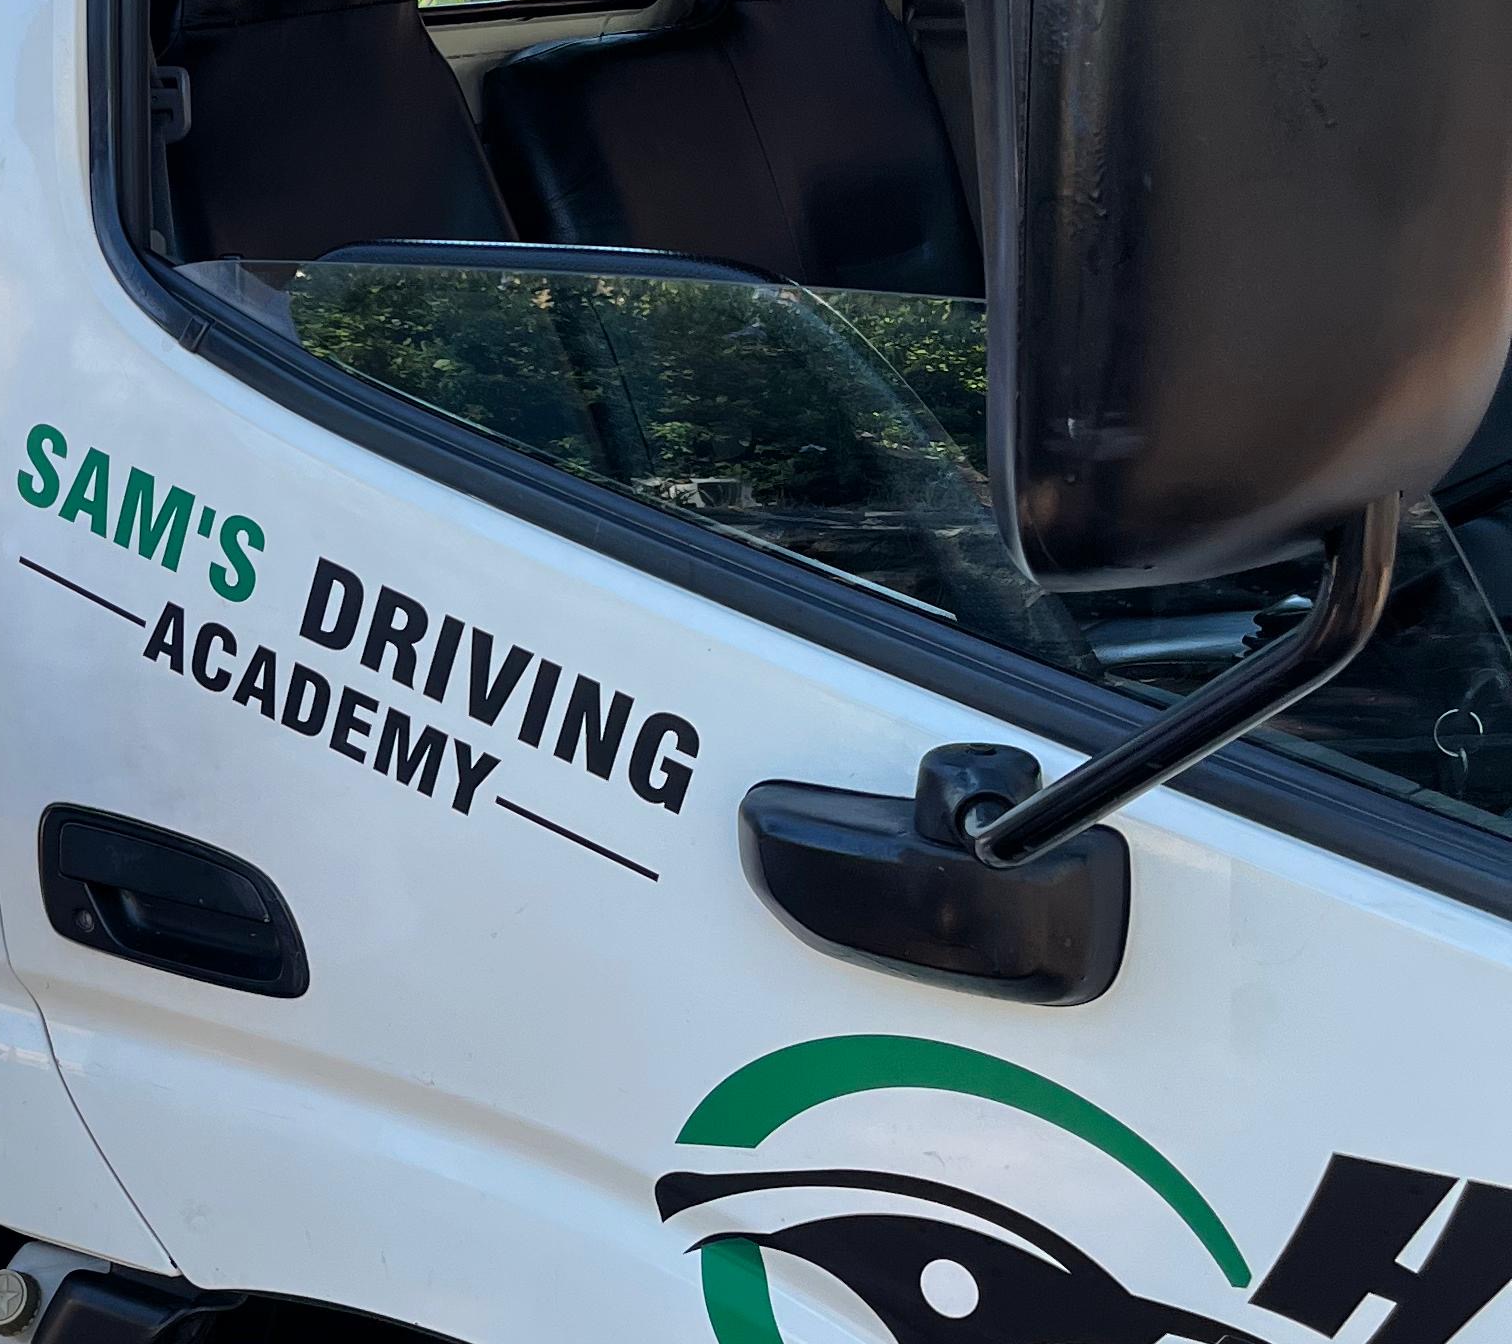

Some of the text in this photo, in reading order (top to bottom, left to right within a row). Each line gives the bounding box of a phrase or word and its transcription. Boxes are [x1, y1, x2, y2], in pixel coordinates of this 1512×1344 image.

[17, 423, 700, 815] SAM'S DRIVING
[143, 601, 502, 816] ACADEMY
